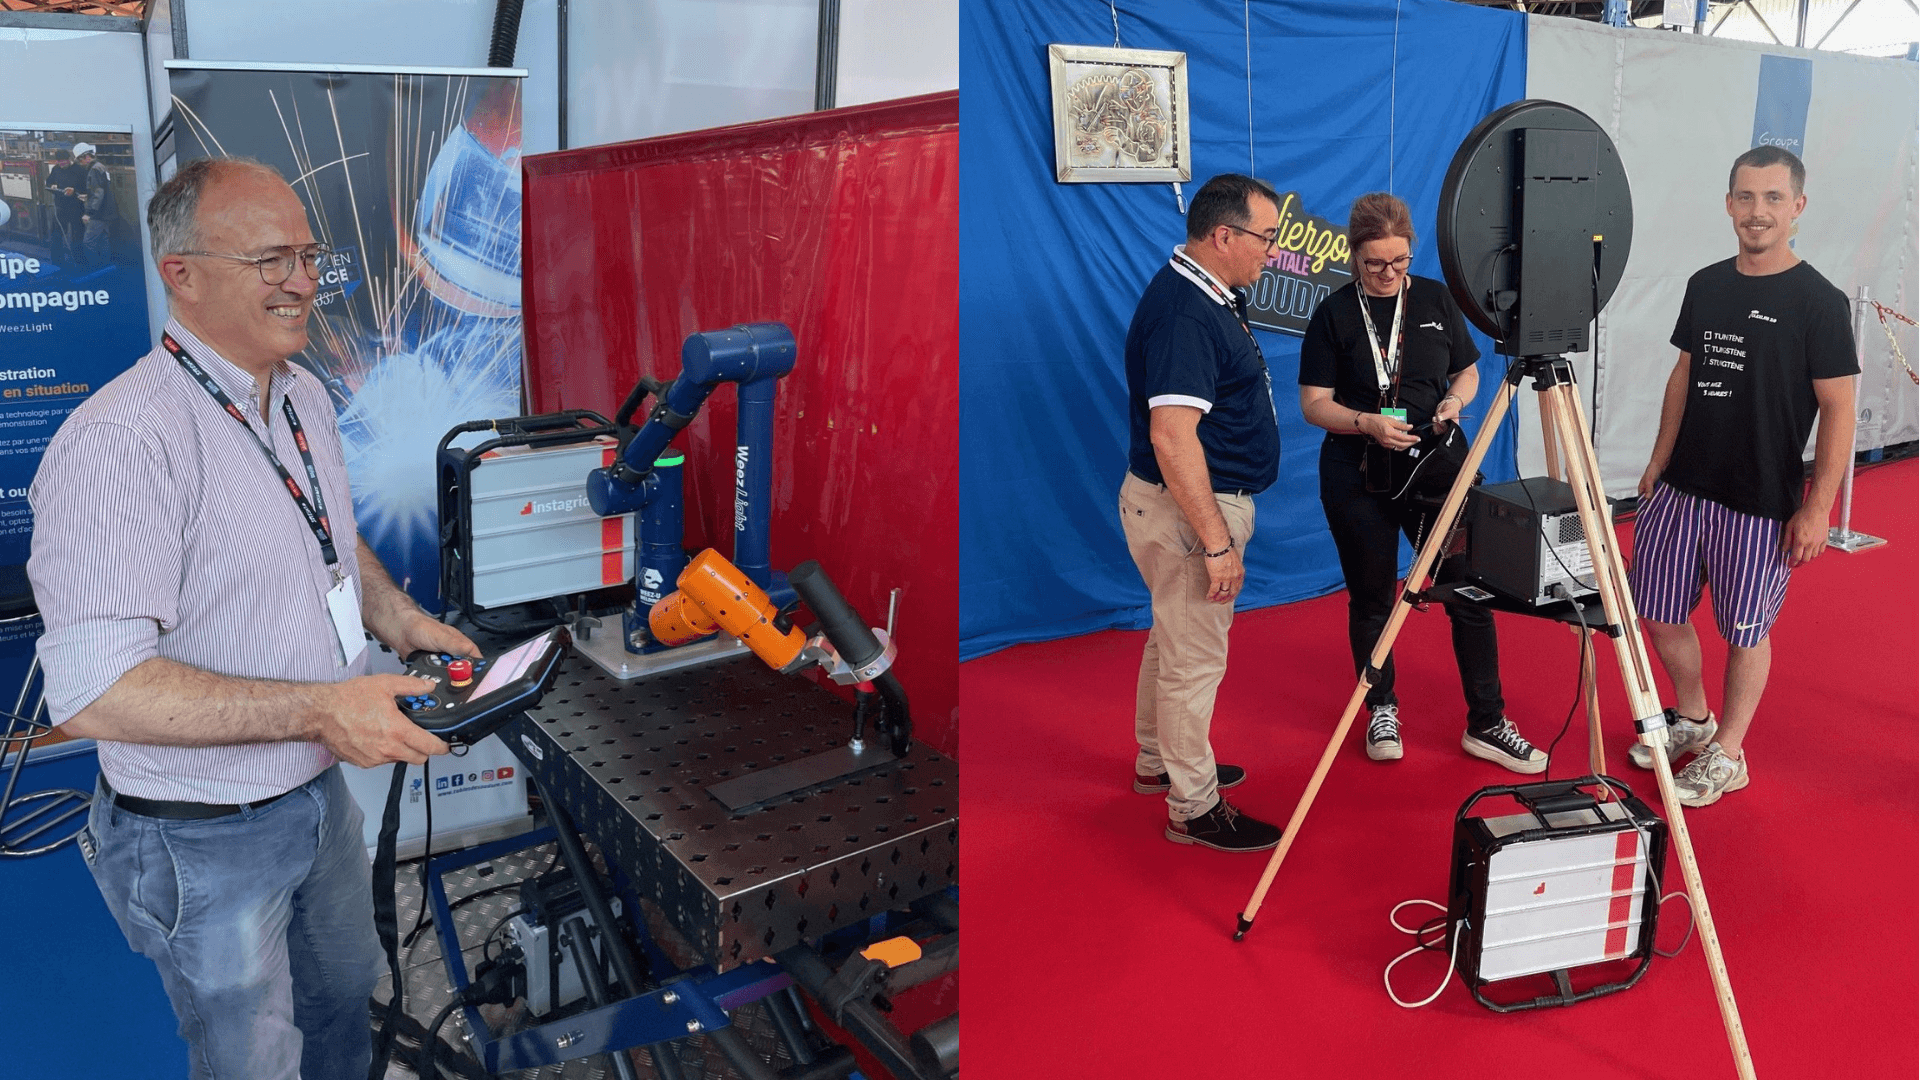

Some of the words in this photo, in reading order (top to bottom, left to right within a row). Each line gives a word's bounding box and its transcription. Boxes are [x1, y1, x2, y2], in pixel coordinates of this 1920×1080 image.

[1758, 131, 1800, 150] Groupe
[0, 254, 40, 279] ipe
[3, 388, 21, 398] en
[26, 382, 89, 397] situation
[6, 408, 50, 418] technologie
[51, 408, 63, 416] par
[8, 487, 27, 498] ou
